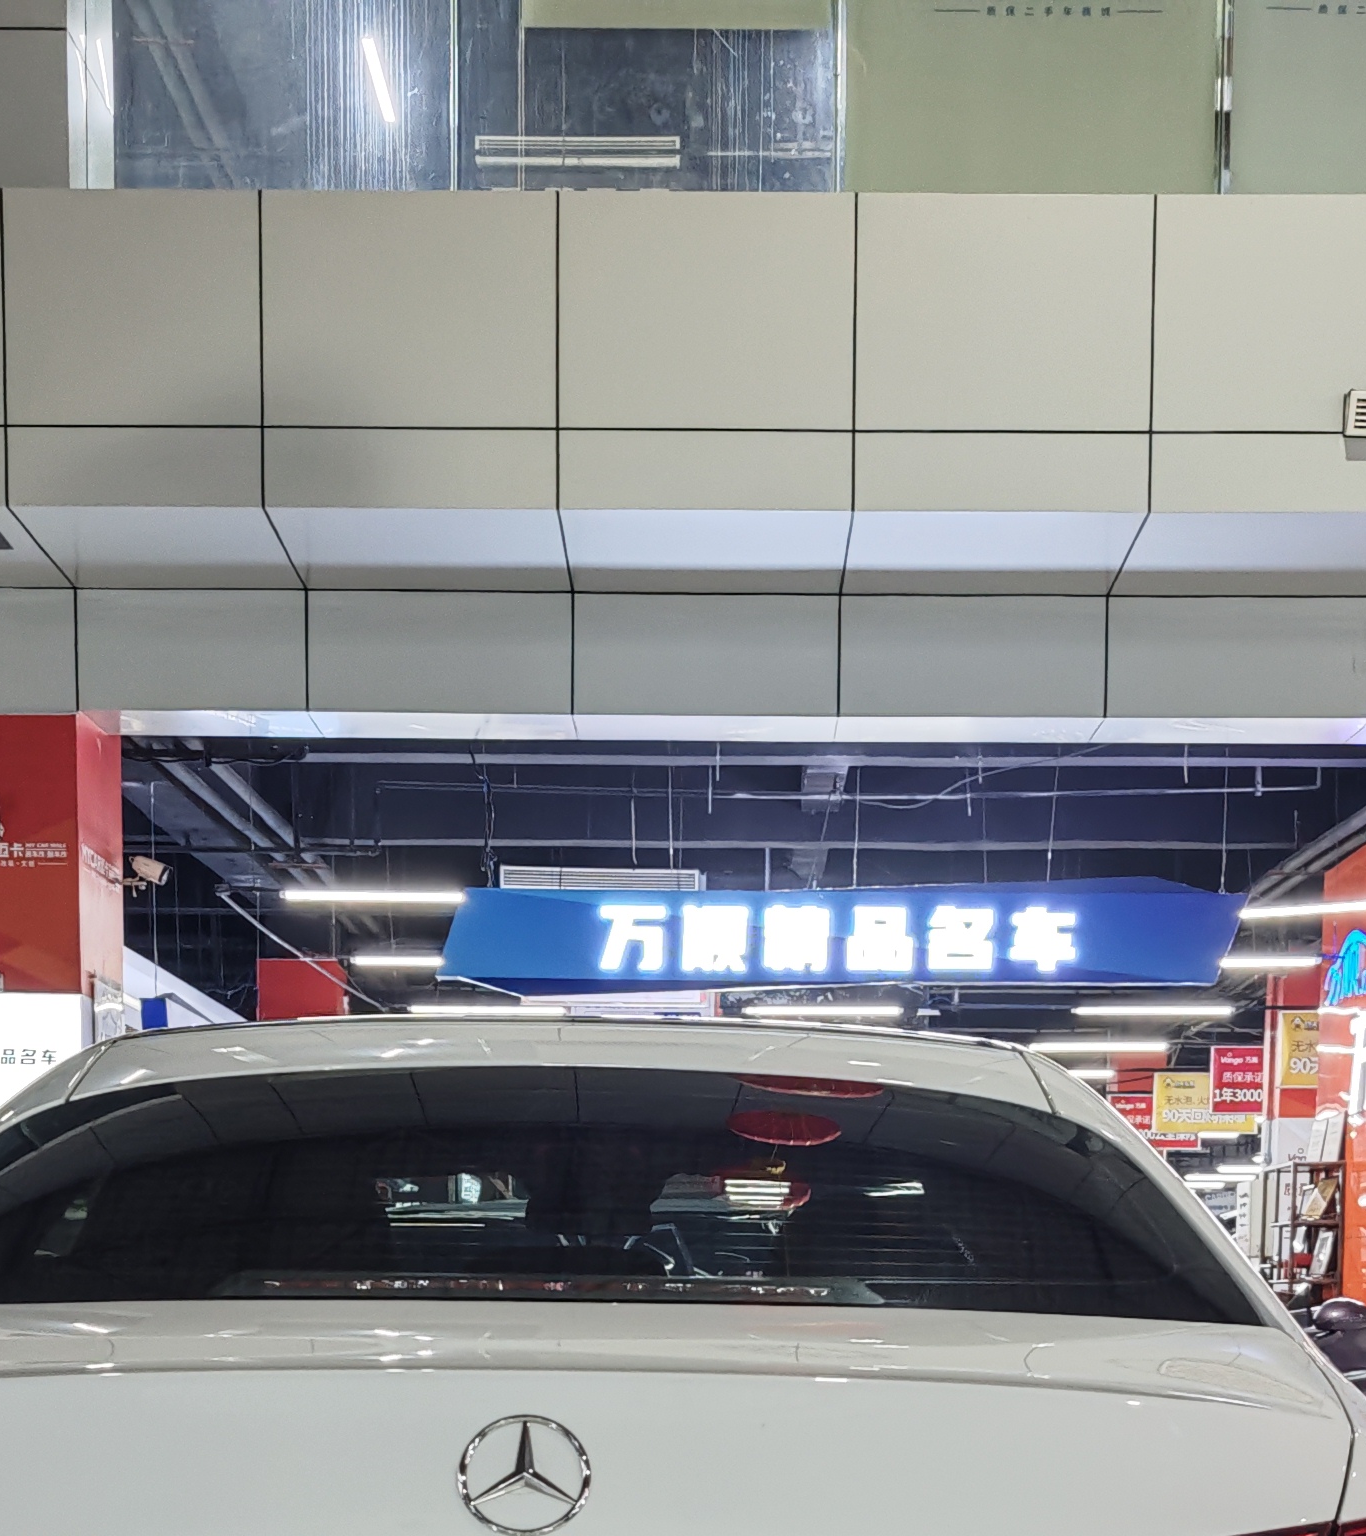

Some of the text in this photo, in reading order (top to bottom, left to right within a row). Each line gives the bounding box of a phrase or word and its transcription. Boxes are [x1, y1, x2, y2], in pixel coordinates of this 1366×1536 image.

[598, 903, 1078, 975] 万顺精品名车
